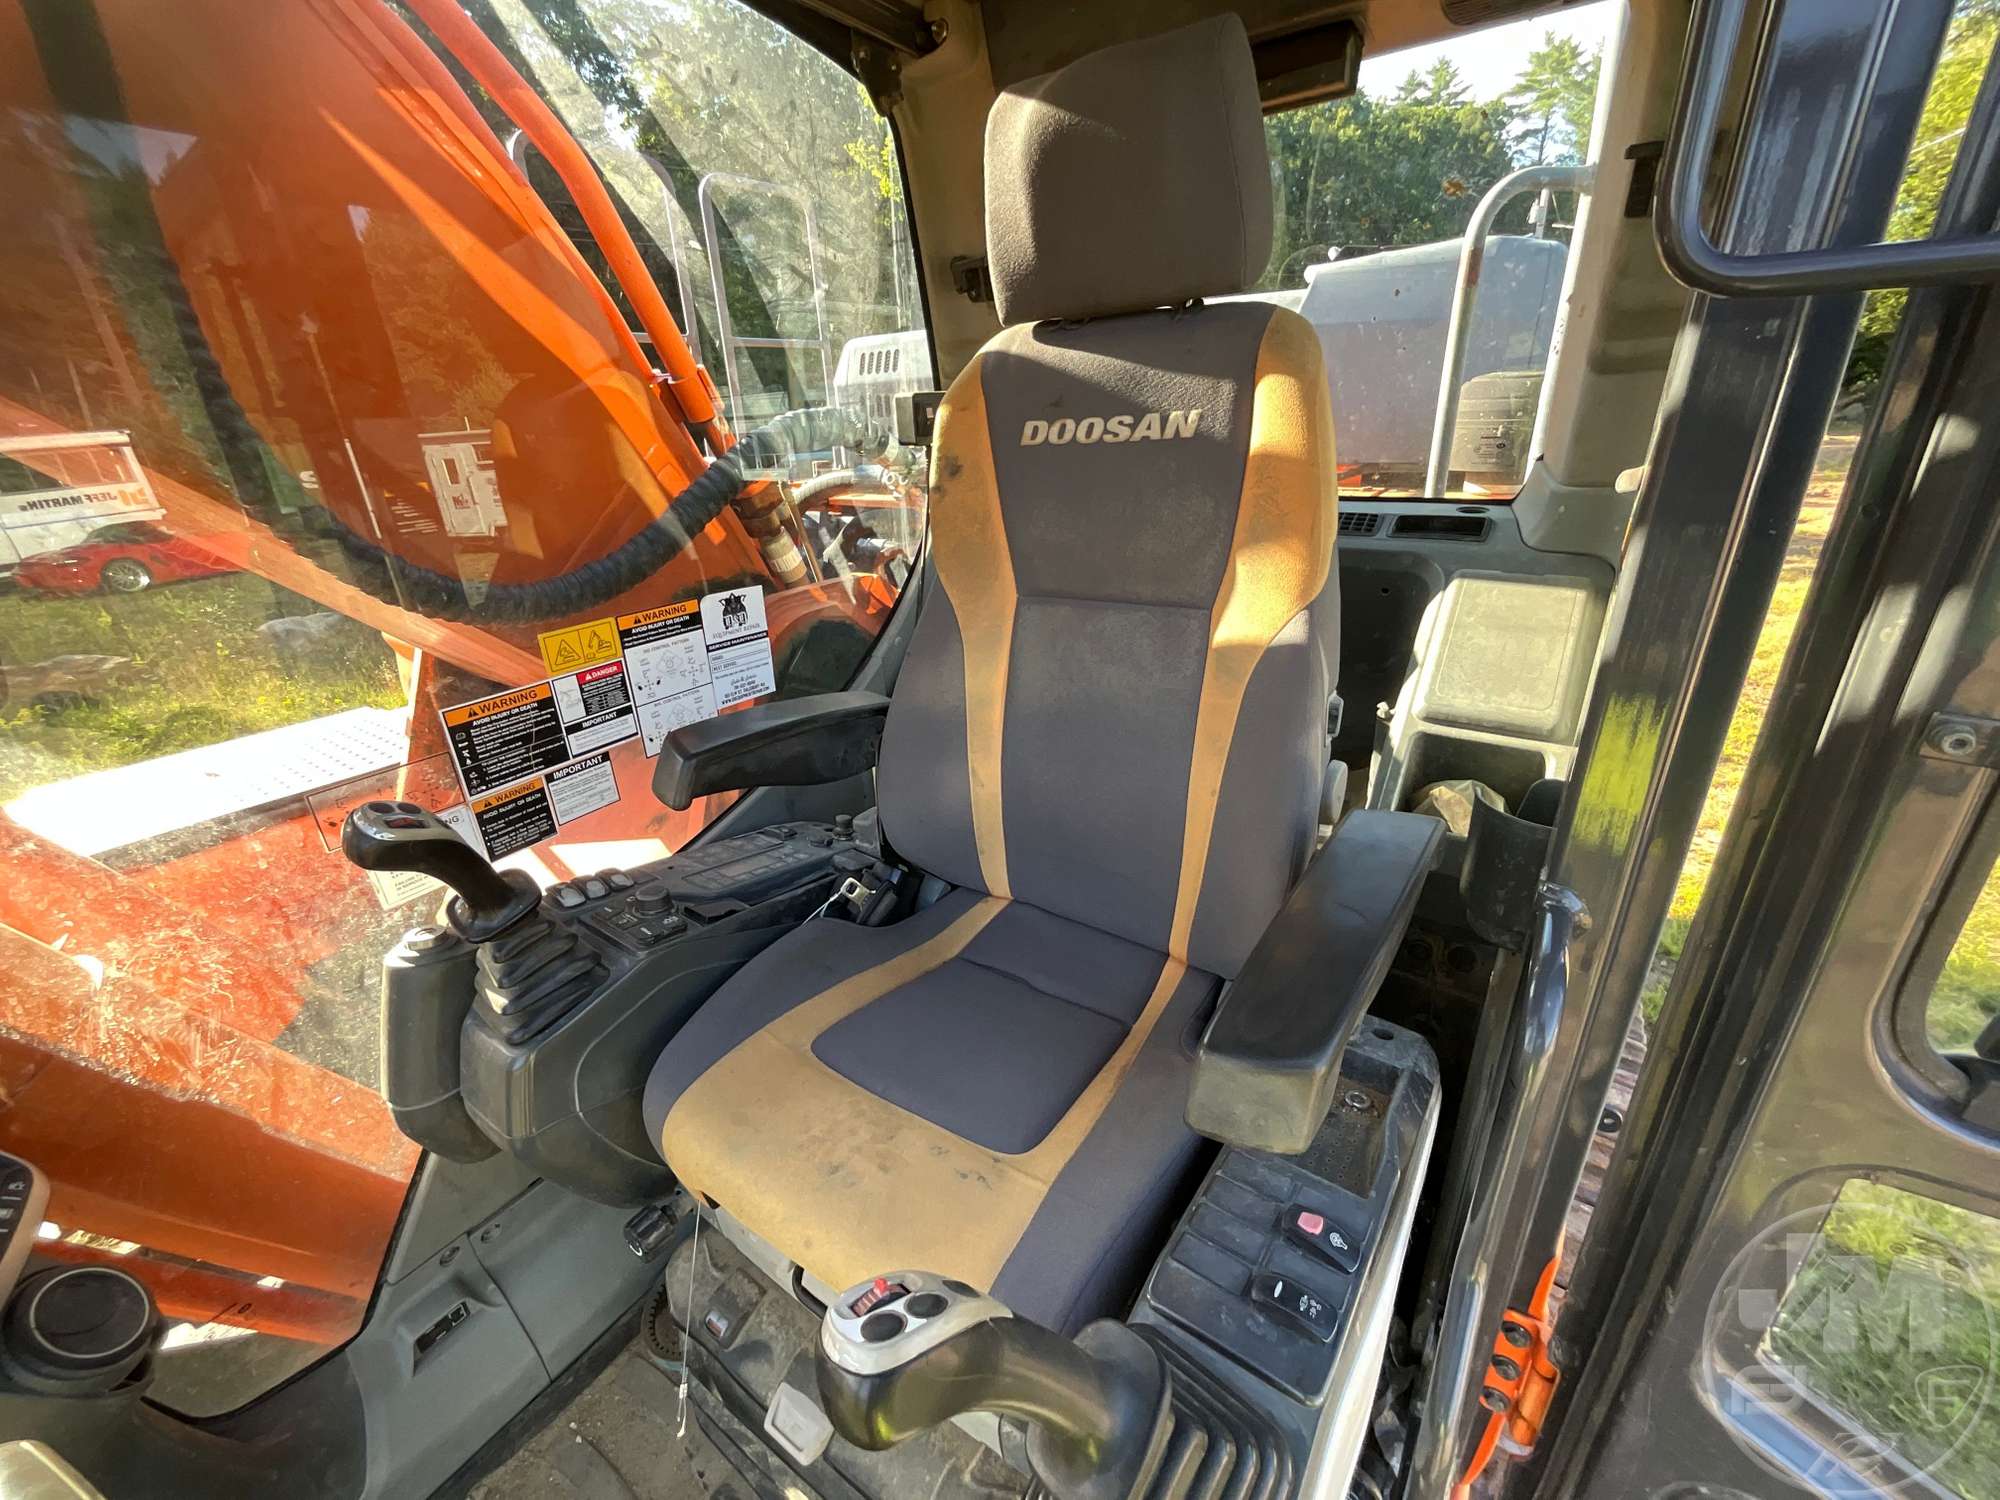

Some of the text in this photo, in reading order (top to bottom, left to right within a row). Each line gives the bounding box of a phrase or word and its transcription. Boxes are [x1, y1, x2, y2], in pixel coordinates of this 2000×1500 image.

[1020, 409, 1201, 446] DOOSAN
[642, 605, 687, 622] WARNING
[632, 626, 648, 634] AVOID
[648, 621, 665, 630] INJURY
[673, 615, 690, 624] DEATH
[708, 641, 731, 651] SERVICE
[592, 665, 618, 678] DANGER
[478, 689, 538, 714] WARNING
[472, 715, 491, 727] AVOID
[491, 710, 511, 722] INJURY
[520, 702, 538, 713] DEATH
[582, 711, 617, 728] IMPORTANT
[553, 755, 603, 780] IMPORTANT
[495, 783, 536, 803] WARNING
